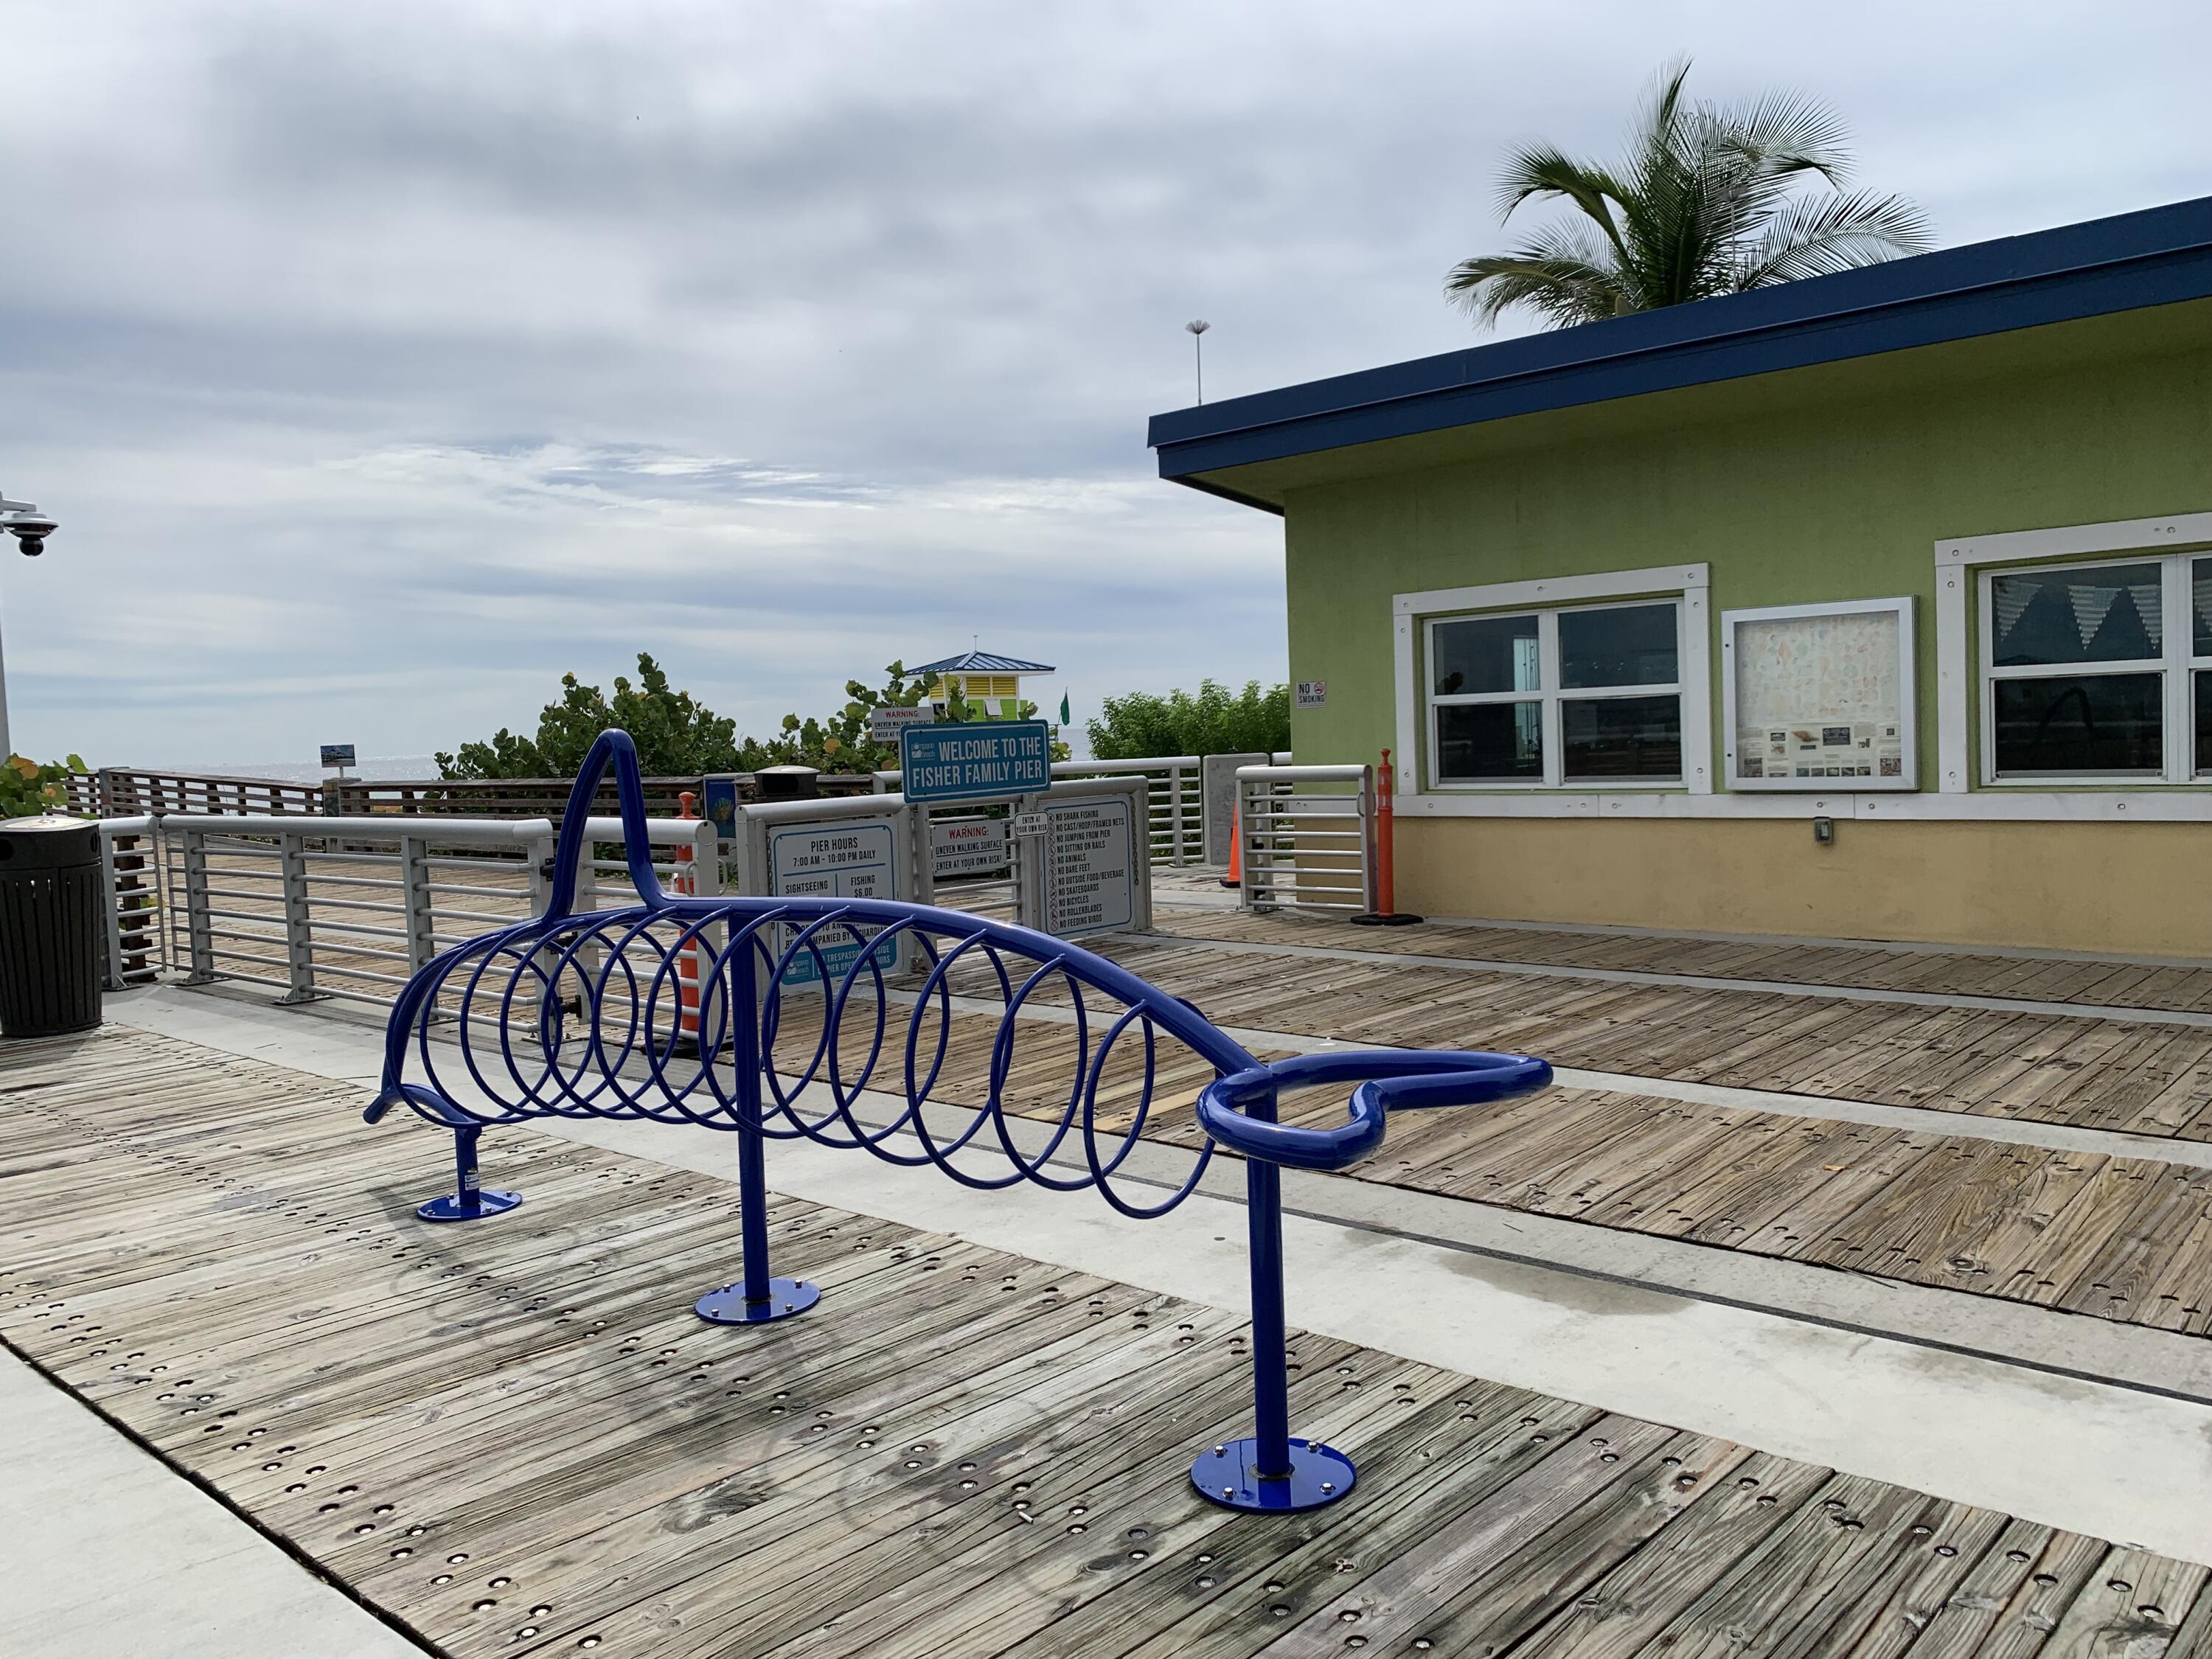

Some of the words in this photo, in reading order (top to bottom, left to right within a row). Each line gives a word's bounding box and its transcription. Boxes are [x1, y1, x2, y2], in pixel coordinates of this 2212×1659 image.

[1299, 683, 1310, 693] NO
[1299, 695, 1324, 703] SMOKING
[939, 739, 999, 762] WELCOME
[1001, 738, 1017, 757] TO
[1019, 737, 1041, 756] THE
[912, 765, 961, 788] FISHER
[965, 762, 1010, 784] FAMILY
[1015, 759, 1042, 779] PIER
[1056, 813, 1062, 821] NO
[1063, 811, 1079, 821] SHARK
[1080, 810, 1099, 819] FISHING
[1017, 825, 1027, 833] YOUR
[1056, 824, 1062, 832] NO
[1113, 818, 1124, 826] NETS
[949, 826, 989, 839] WARNING:
[1057, 834, 1063, 843] NO
[1064, 832, 1085, 842] JUMPING
[1086, 830, 1099, 839] FROM
[1100, 830, 1110, 838] PIER
[811, 840, 830, 852] PIER
[832, 838, 858, 850] HOURS
[936, 846, 956, 855] UNEVEN
[957, 842, 979, 852] WALKING
[981, 839, 1002, 849] SURFACE
[1057, 845, 1063, 853] NO
[1065, 843, 1083, 852] SITTING
[1084, 842, 1091, 850] ON
[1092, 841, 1105, 849] RAILS
[793, 857, 808, 867] 7:00
[810, 855, 820, 866] AM
[827, 853, 846, 863] 10:00
[848, 852, 858, 862] PM
[859, 849, 876, 860] DAILY
[936, 861, 952, 871] ENTER
[953, 860, 960, 869] AT
[961, 858, 975, 867] YOUR
[976, 857, 987, 866] OWN
[989, 855, 1002, 864] RISK!
[1057, 855, 1064, 863] NO
[1065, 853, 1086, 863] ANIMALS
[1057, 866, 1064, 875] NO
[1065, 865, 1077, 874] BARE
[1079, 863, 1090, 872] FEET
[851, 874, 875, 886] FISHING
[1058, 877, 1065, 885] NO
[1066, 874, 1085, 884] OUTSIDE
[1087, 869, 1124, 882] FOOD/BEVERAGE
[785, 880, 828, 894] SIGHTSEEING
[855, 887, 872, 898] $6.00
[1059, 887, 1065, 896] NO
[1066, 883, 1099, 895] SKATEBOARDS
[1059, 898, 1065, 907] NO
[1067, 895, 1089, 905] BICYCLES
[1060, 908, 1066, 917] NO
[1067, 903, 1102, 917] ROLLERBLADES
[1060, 919, 1066, 928] NO
[1068, 917, 1087, 927] FEEDING
[1088, 914, 1102, 923] BIRDS
[843, 931, 850, 941] BY
[827, 949, 865, 962] TRESPASSIN
[827, 963, 840, 973] PIER
